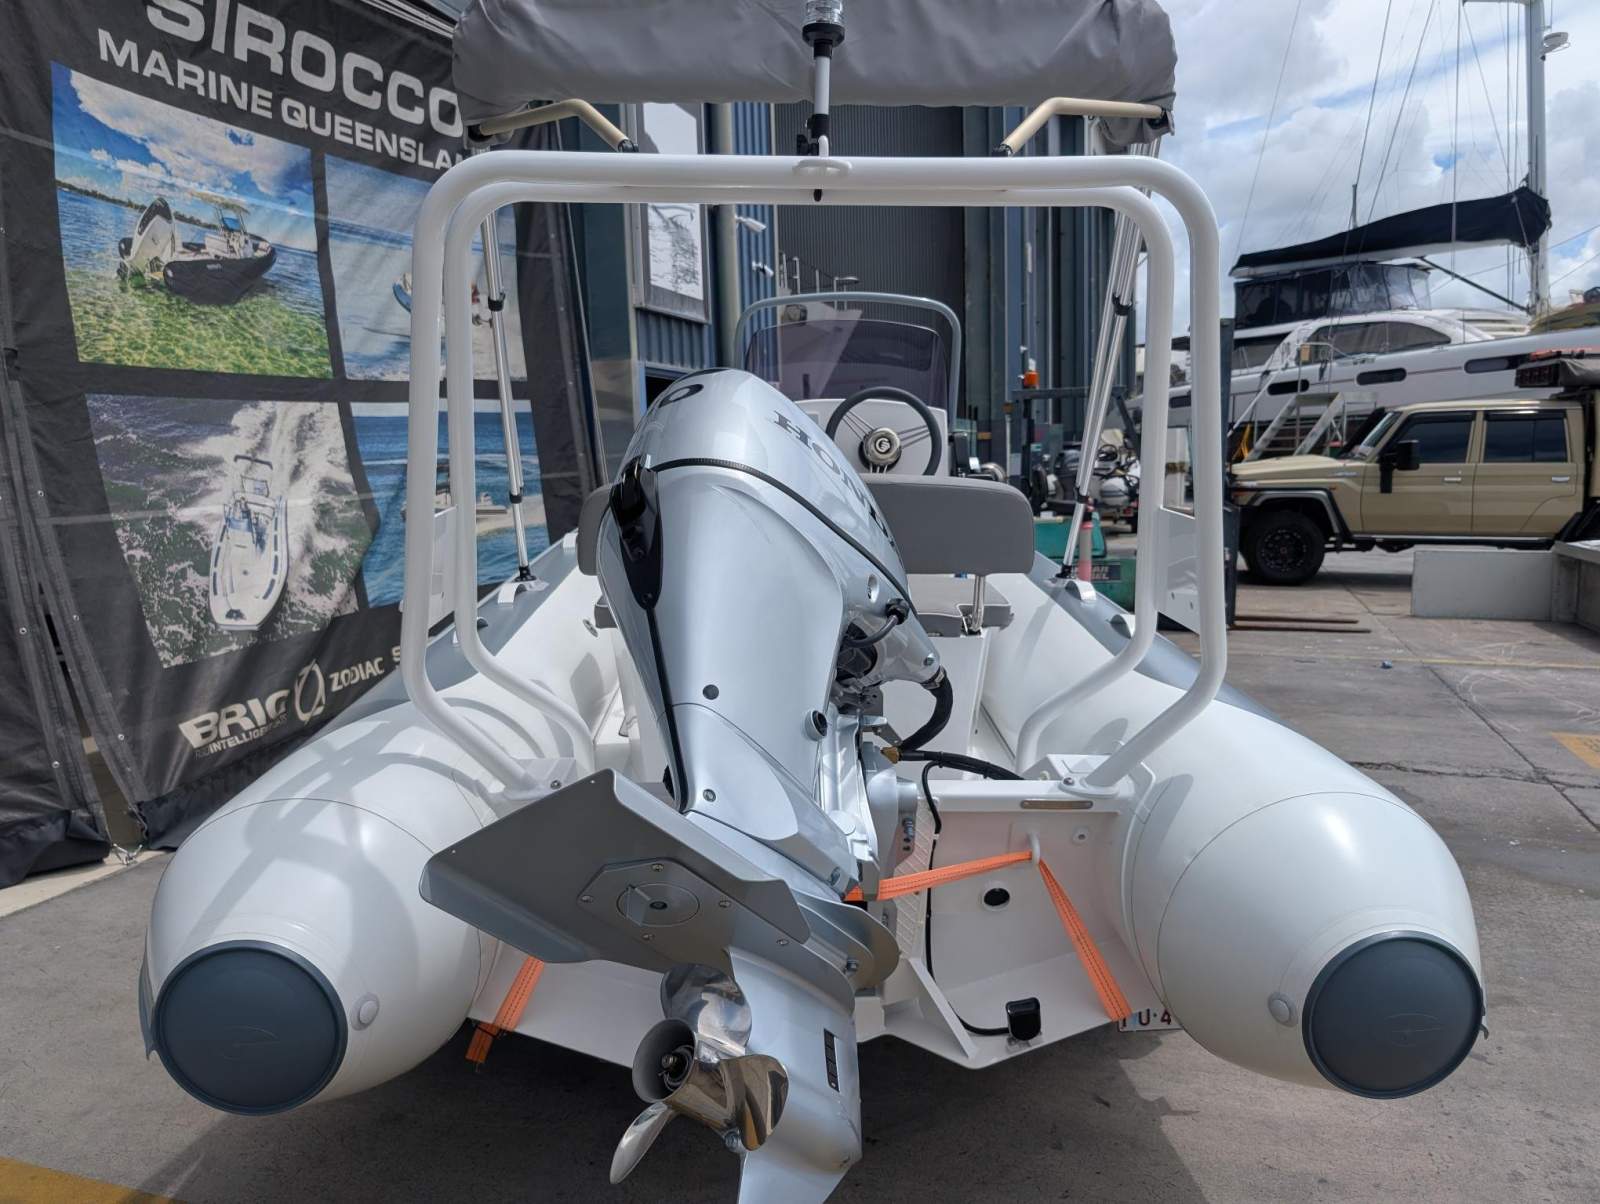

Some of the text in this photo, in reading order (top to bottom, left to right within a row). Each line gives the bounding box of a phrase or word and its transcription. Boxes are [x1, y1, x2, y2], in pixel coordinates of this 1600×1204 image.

[98, 28, 463, 170] MARINE QUEENSLA
[147, 0, 464, 138] SIROCCO
[329, 656, 385, 692] ZODIAC
